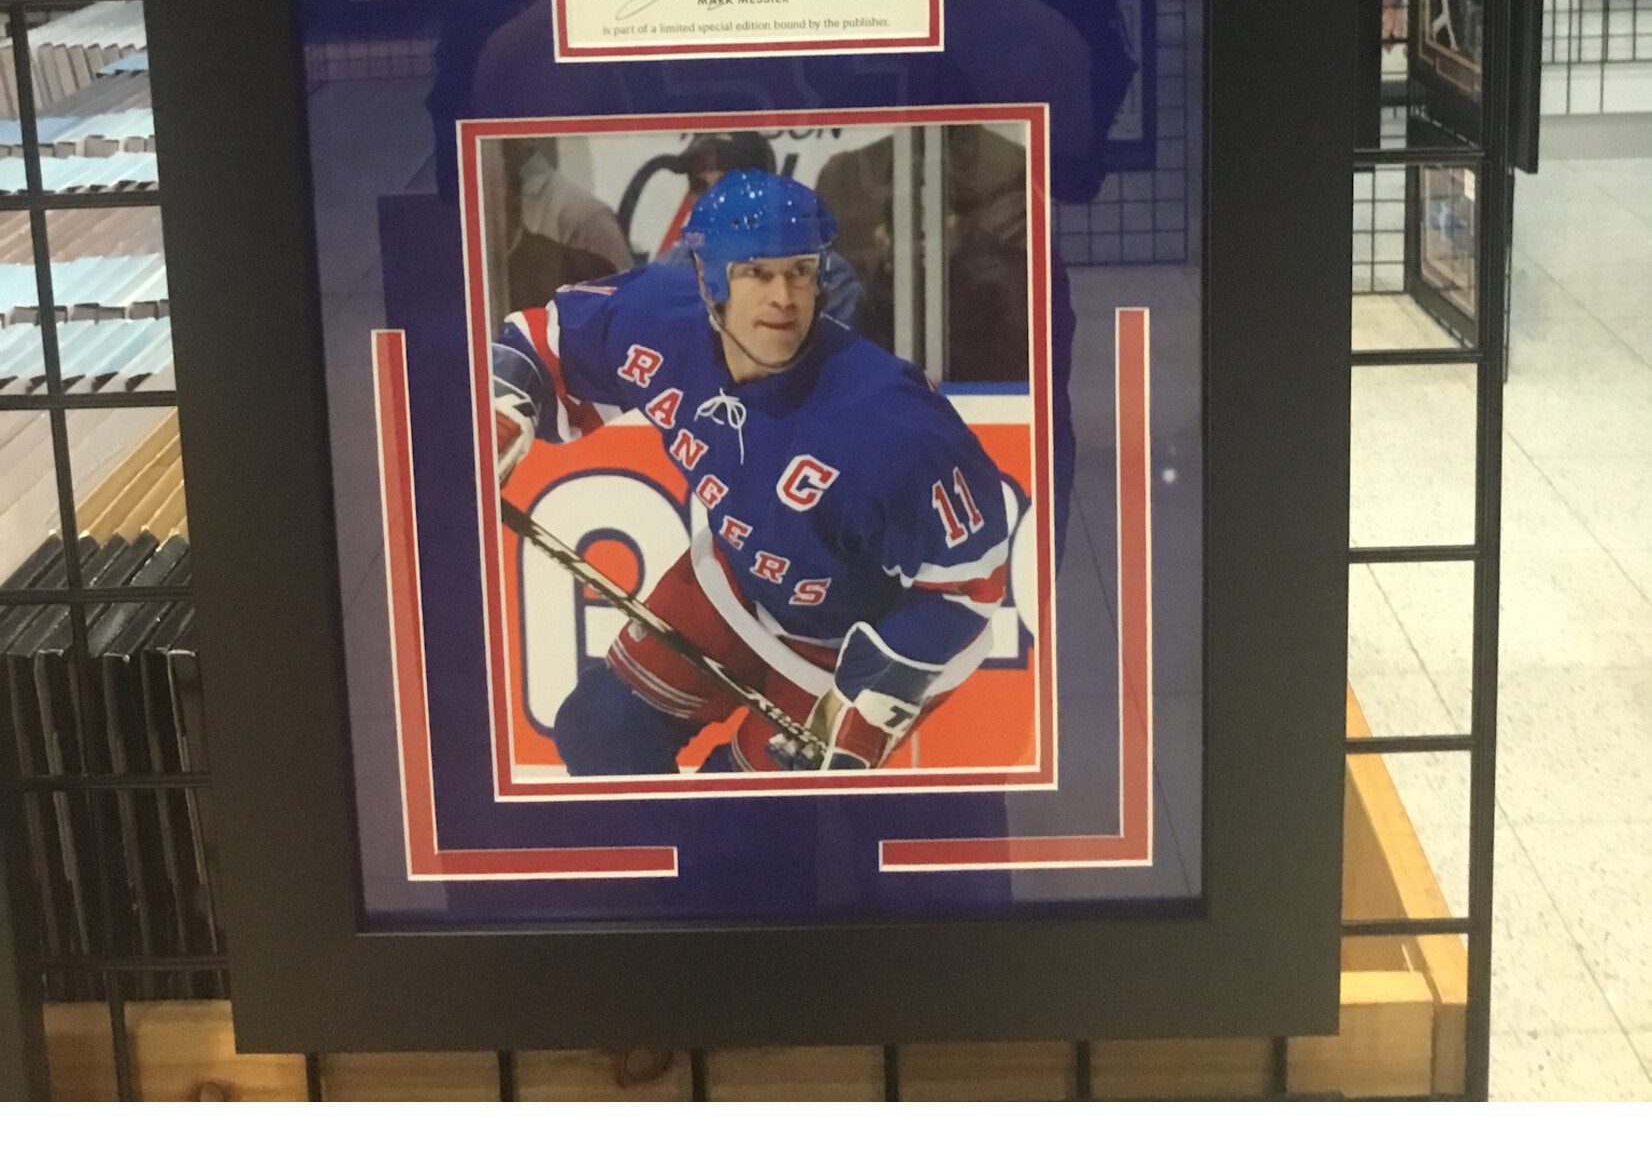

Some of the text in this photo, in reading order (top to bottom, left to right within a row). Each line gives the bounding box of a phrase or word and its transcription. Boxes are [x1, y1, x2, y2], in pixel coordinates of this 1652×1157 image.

[603, 26, 611, 35] is
[613, 25, 635, 37] part
[637, 23, 648, 34] of
[660, 23, 695, 33] limited
[698, 21, 733, 33] special
[735, 20, 771, 31] edition
[774, 18, 806, 30] bound
[808, 17, 820, 30] by
[824, 18, 840, 28] the
[842, 16, 890, 29] publisher.
[617, 344, 831, 607] RANGERS
[775, 454, 839, 513] C
[930, 465, 984, 548] 11
